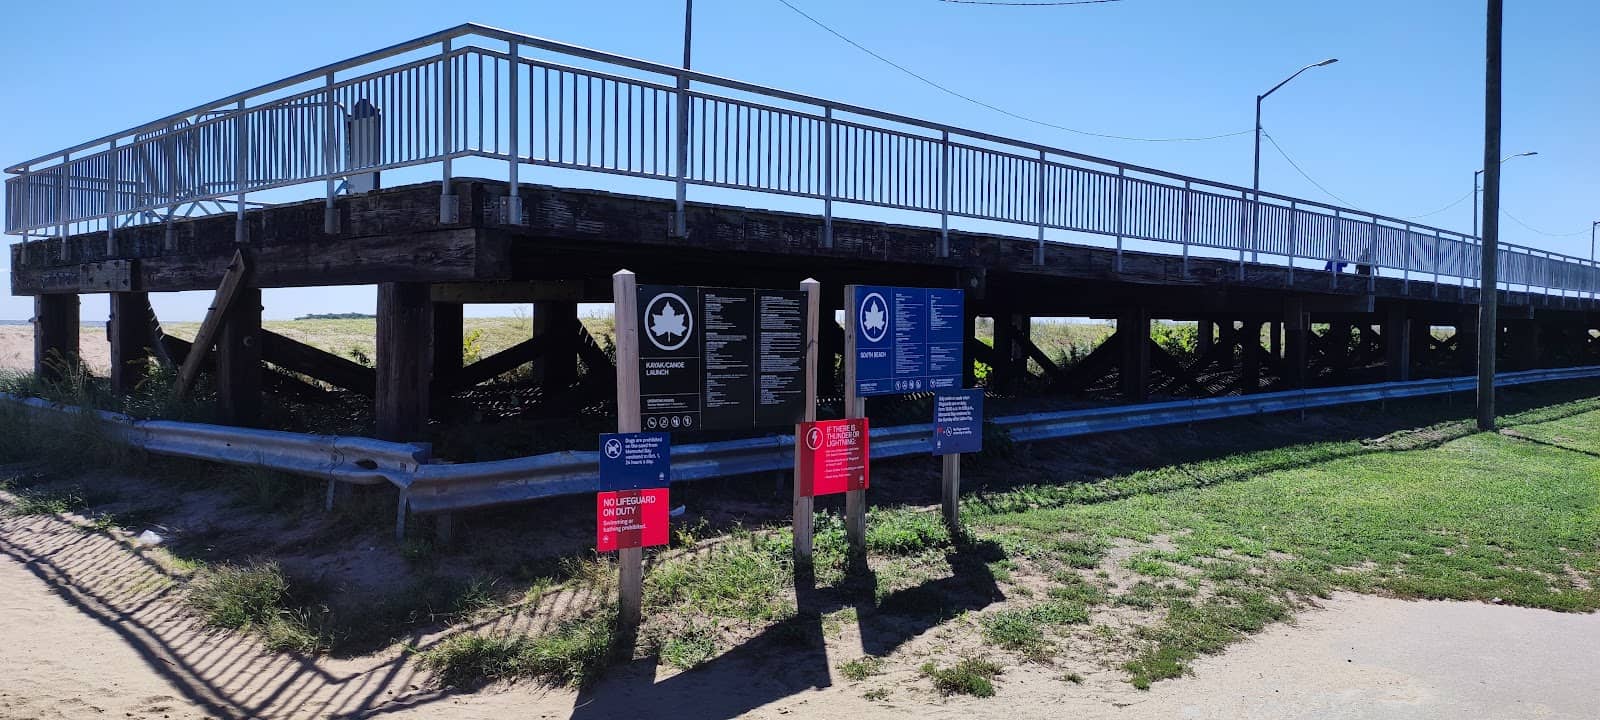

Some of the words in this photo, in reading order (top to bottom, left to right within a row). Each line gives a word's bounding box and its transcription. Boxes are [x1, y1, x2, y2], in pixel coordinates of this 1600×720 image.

[832, 424, 850, 432] THERE
[826, 432, 852, 440] THUNDER
[826, 438, 857, 448] LIGHTNING:
[603, 498, 615, 507] NO
[616, 496, 656, 506] LIFEGUARD
[603, 508, 615, 517] ON
[616, 506, 636, 516] DUTY
